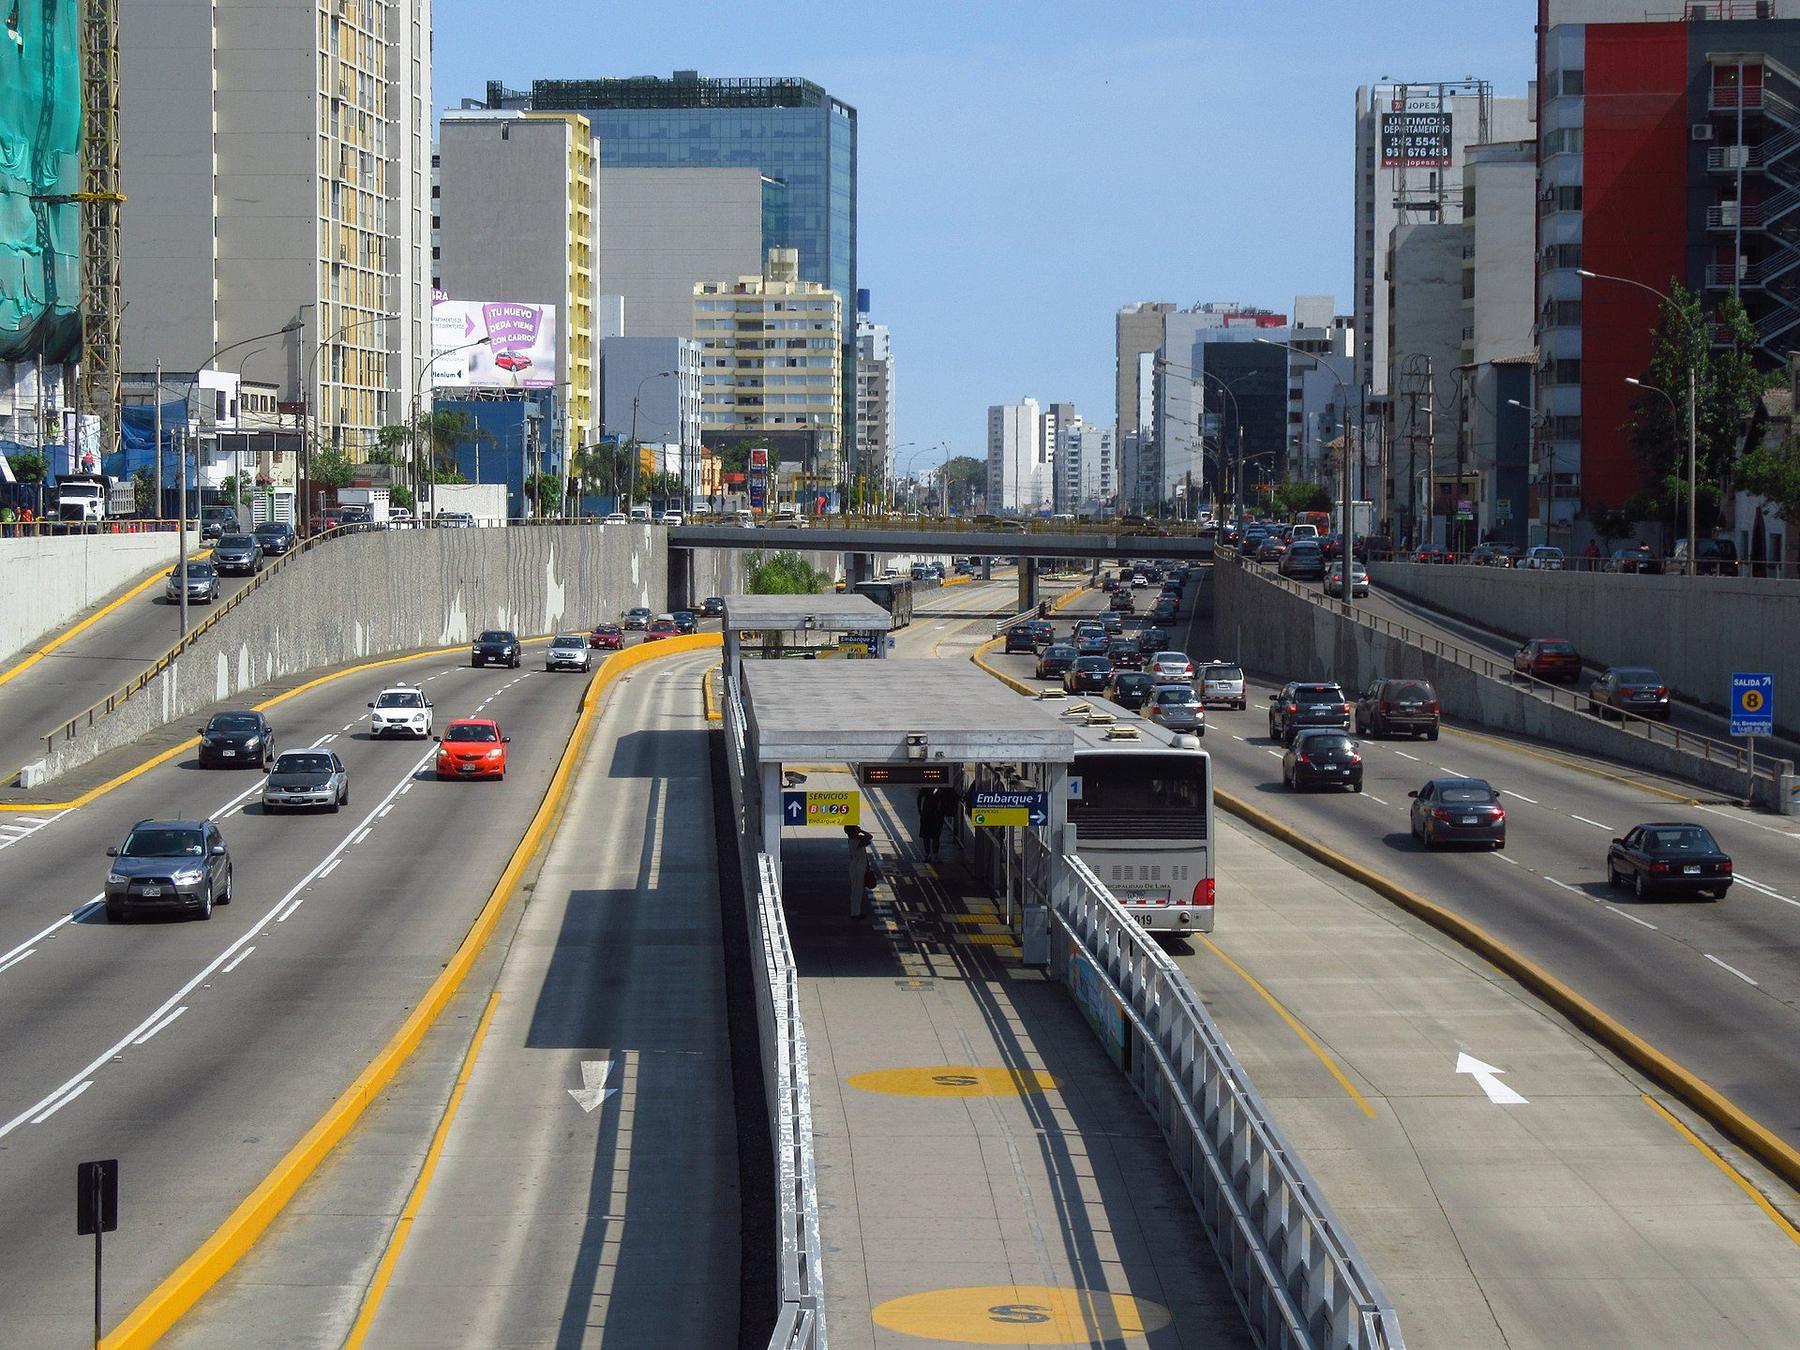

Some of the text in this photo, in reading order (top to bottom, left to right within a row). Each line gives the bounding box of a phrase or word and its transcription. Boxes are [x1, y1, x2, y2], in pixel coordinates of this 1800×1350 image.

[1384, 125, 1450, 133] DEPRTAMENTS
[1407, 147, 1427, 157] 676
[504, 307, 532, 319] NUEVO
[490, 320, 534, 333] DEPA VIENE
[492, 336, 507, 346] CON
[888, 639, 895, 647] 2
[1734, 678, 1761, 687] SALIDA
[1747, 693, 1759, 708] 8
[1070, 781, 1079, 794] 1
[808, 792, 849, 801] SERVICIOS
[976, 793, 1043, 805] Embarque 1
[1131, 914, 1152, 925] 019
